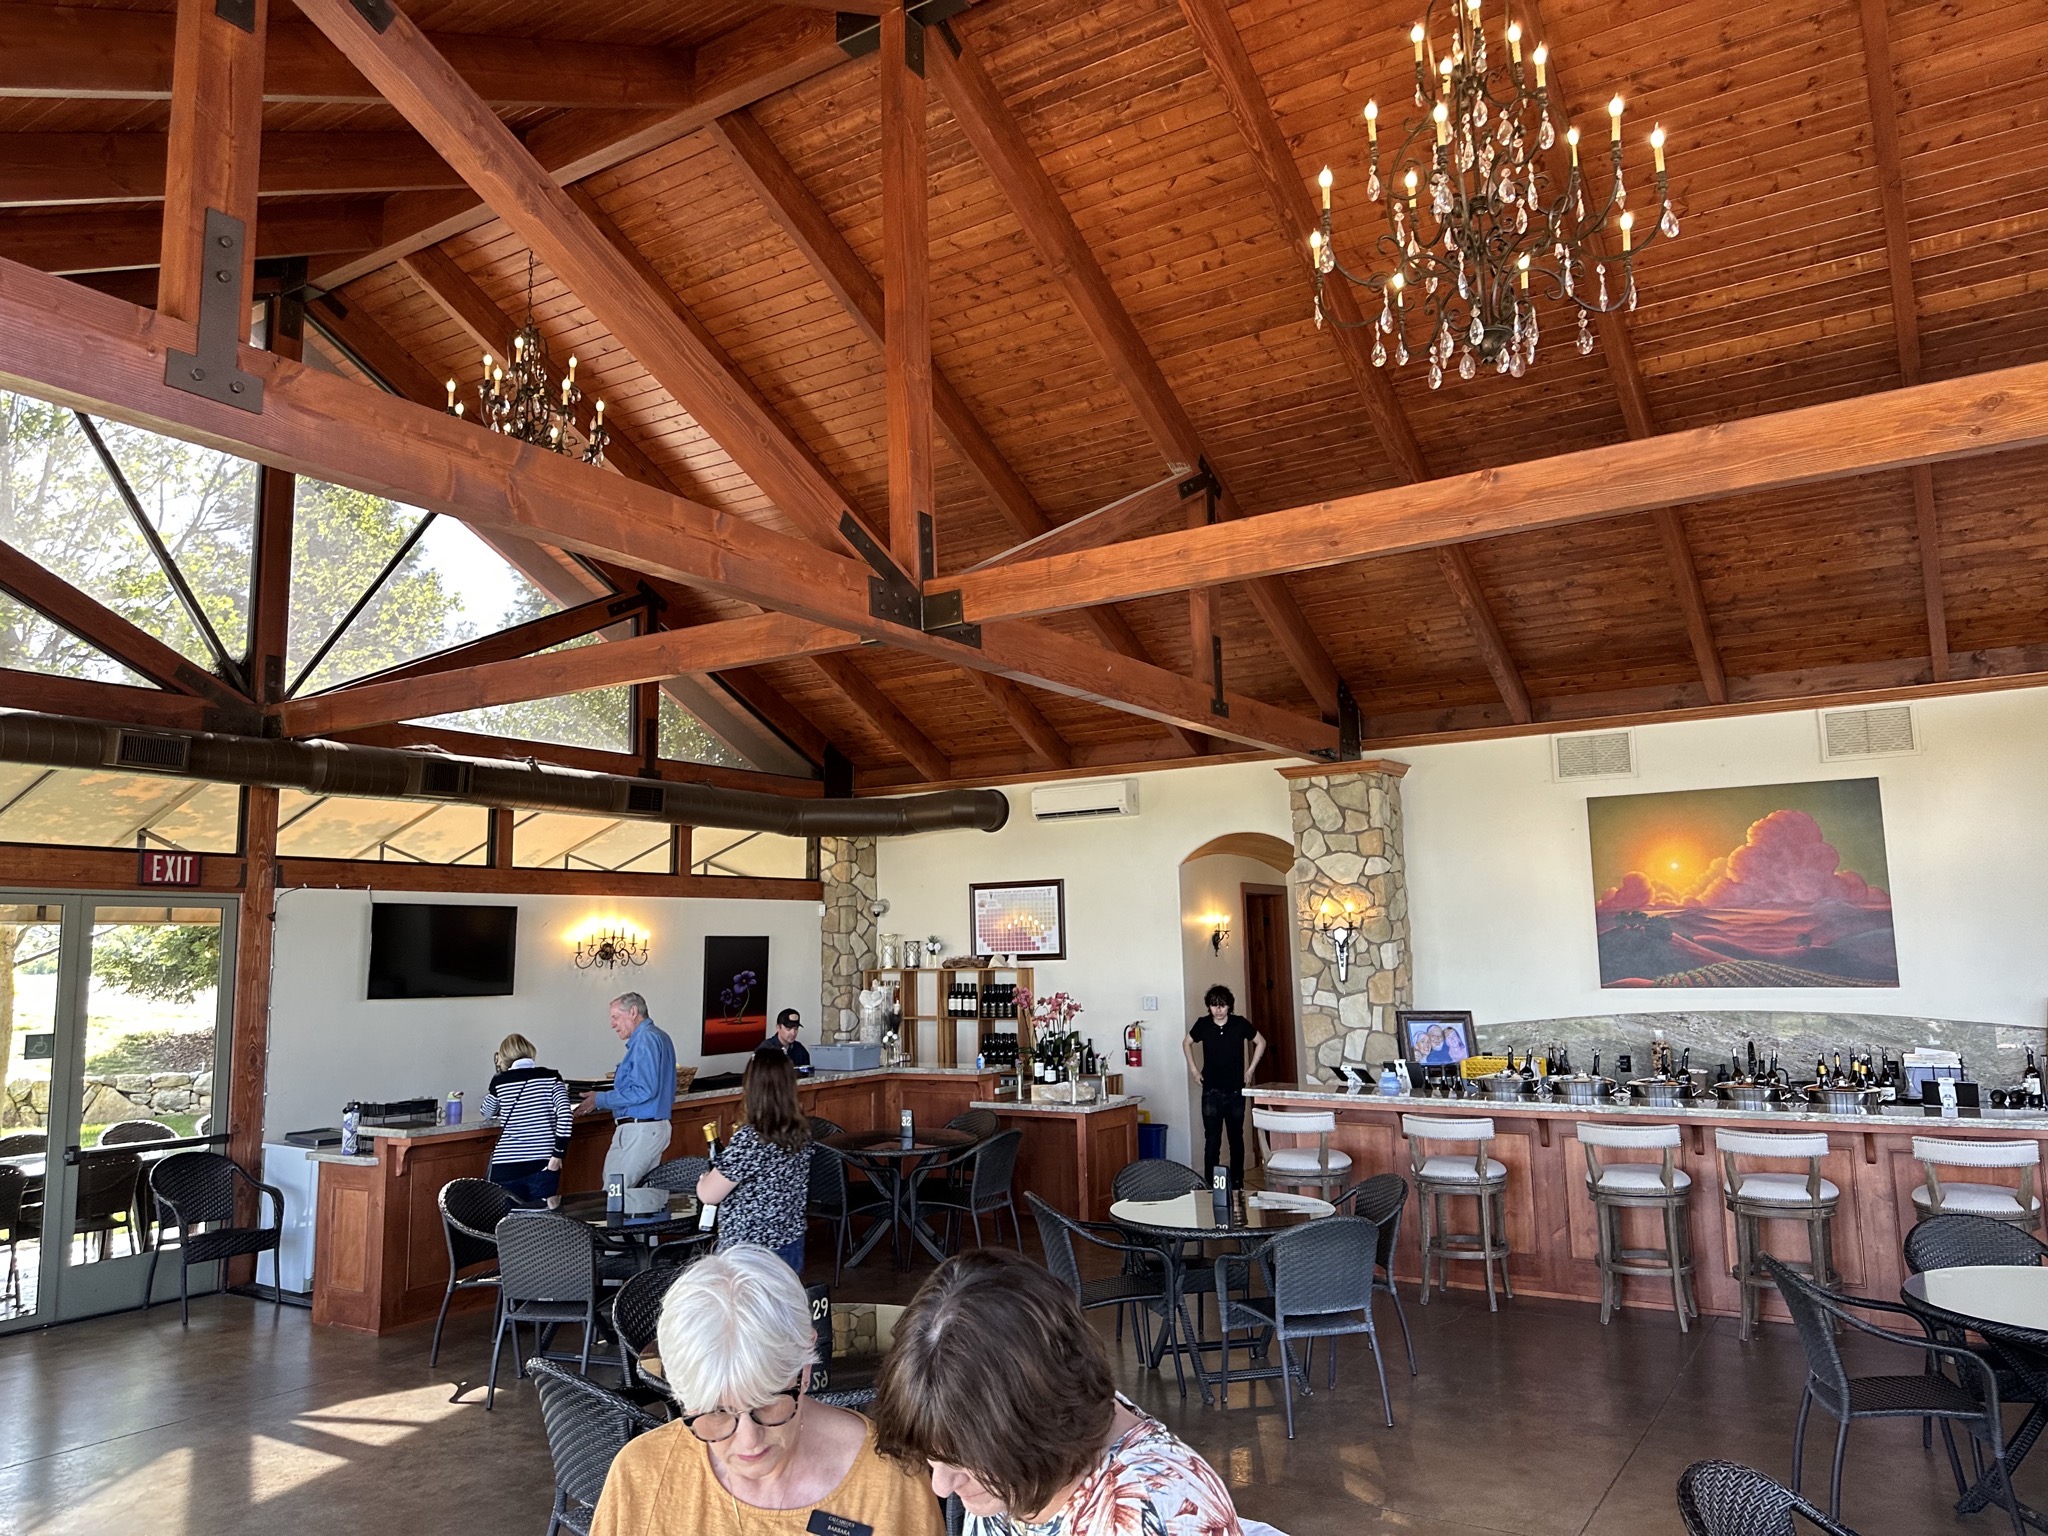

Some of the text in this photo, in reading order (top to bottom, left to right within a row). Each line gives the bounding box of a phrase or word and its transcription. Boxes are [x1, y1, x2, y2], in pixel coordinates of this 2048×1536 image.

[152, 854, 193, 883] EXIT
[901, 1116, 912, 1127] 32
[1213, 1175, 1226, 1190] 30
[608, 1183, 622, 1197] 31
[812, 1297, 829, 1321] 29
[827, 1524, 850, 1536] BARBARA
